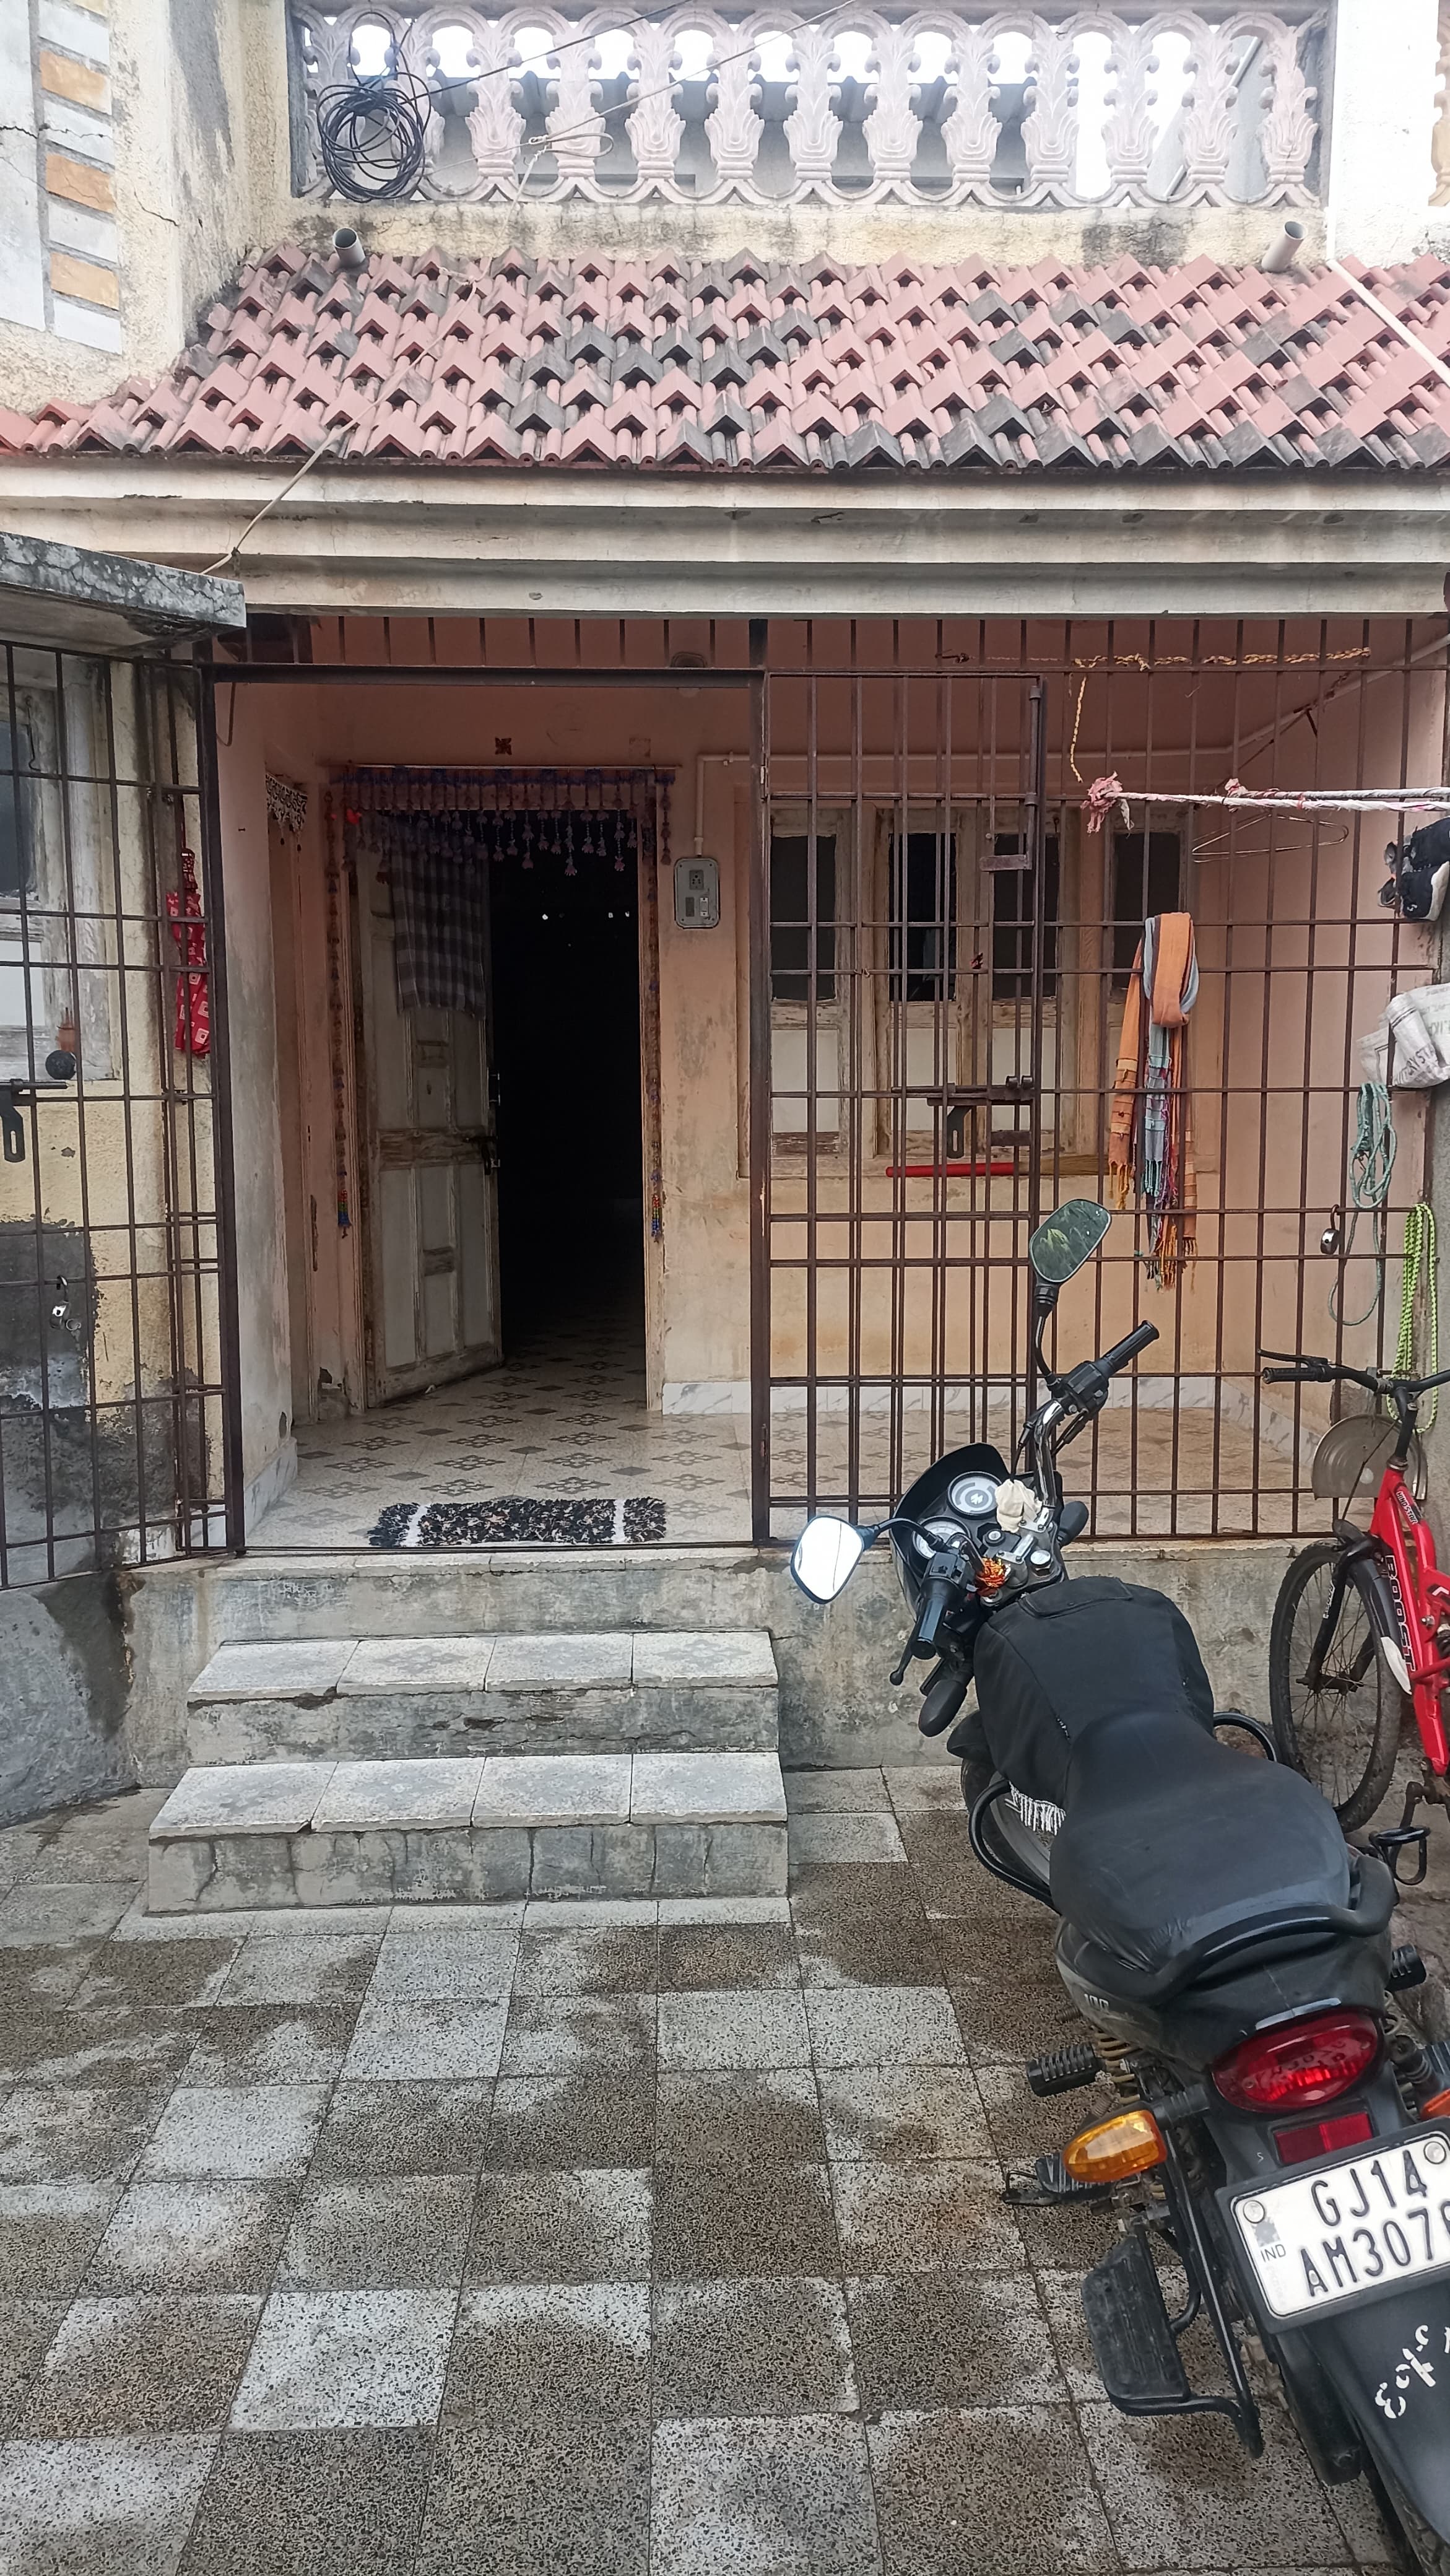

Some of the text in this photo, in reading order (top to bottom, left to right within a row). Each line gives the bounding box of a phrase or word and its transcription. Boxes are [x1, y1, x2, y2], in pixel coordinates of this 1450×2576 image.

[1385, 1555, 1417, 1672] BOOST
[1311, 2149, 1427, 2227] GJ14
[1260, 2243, 1287, 2263] IND
